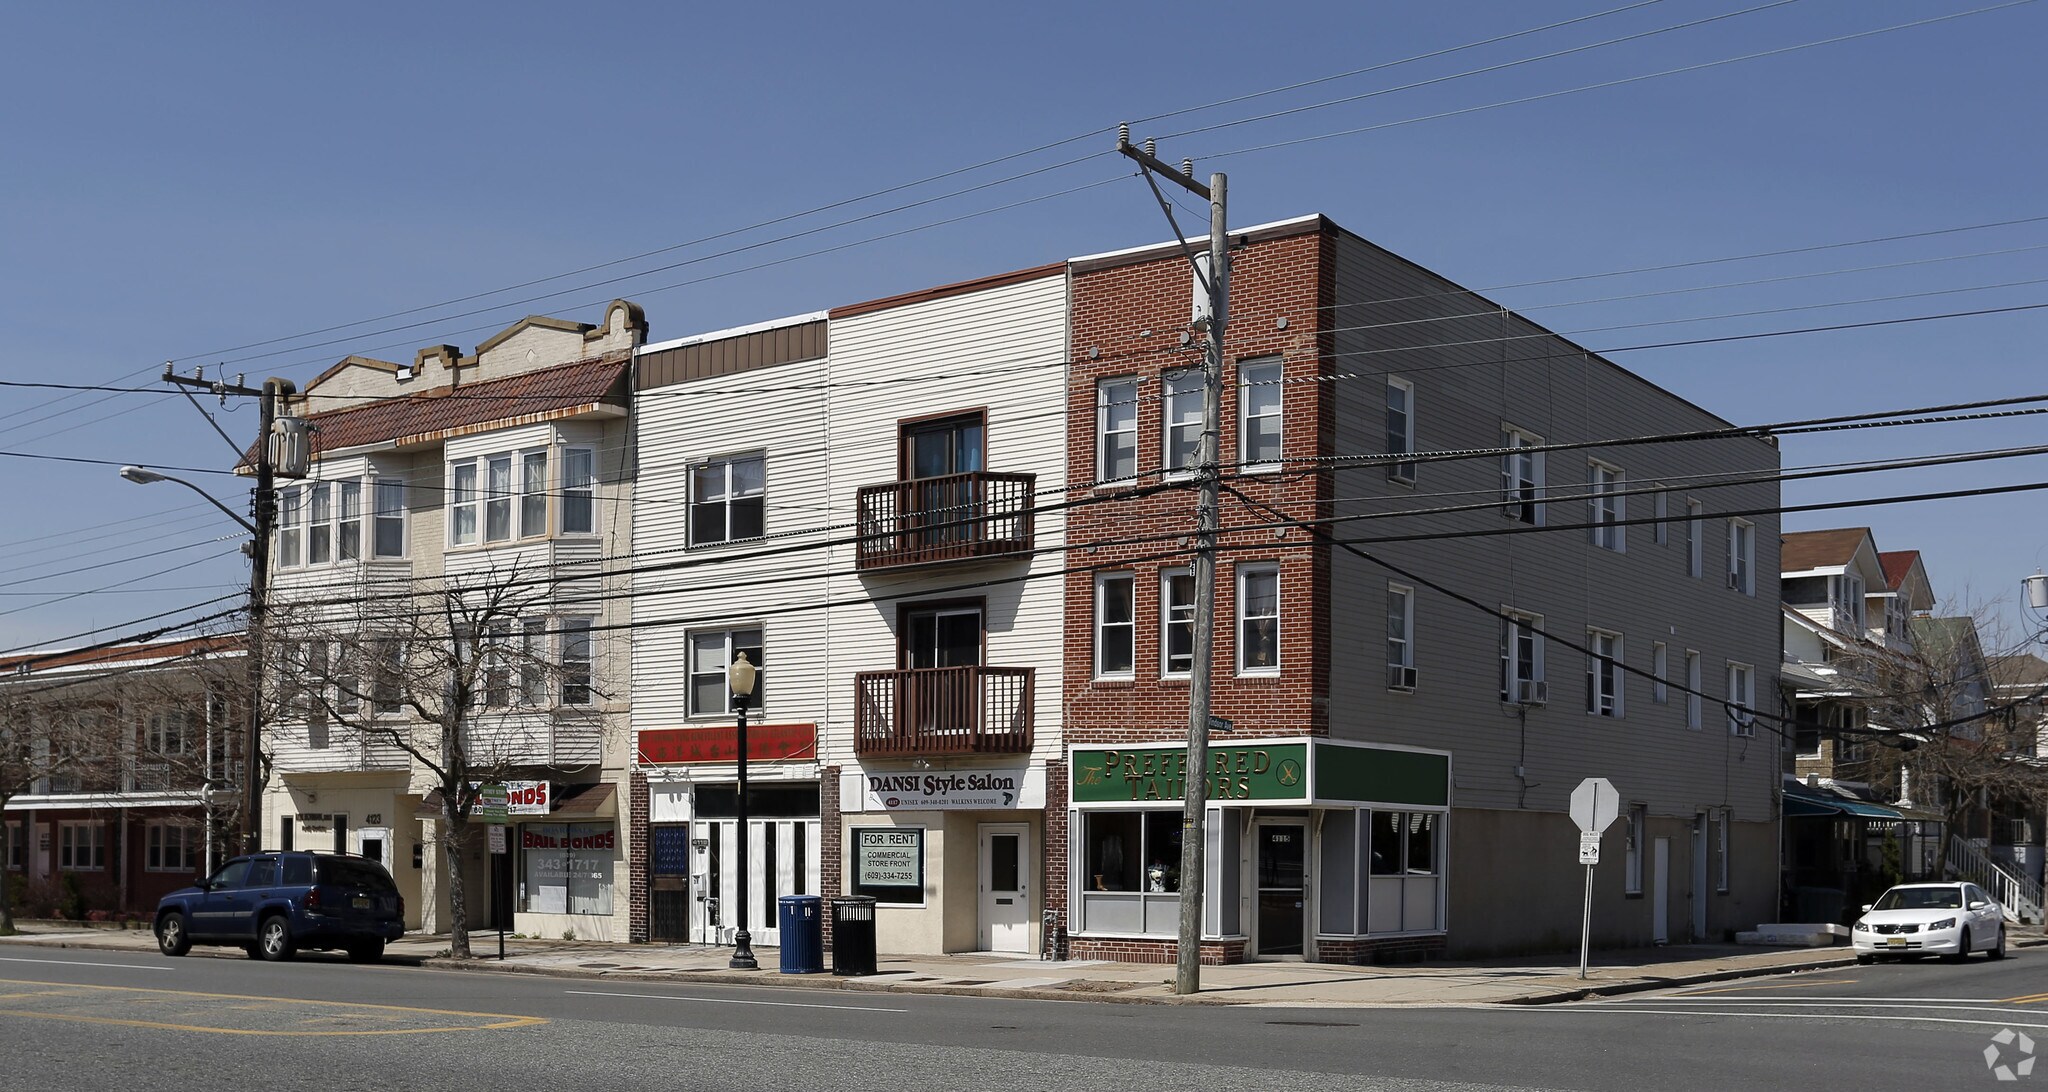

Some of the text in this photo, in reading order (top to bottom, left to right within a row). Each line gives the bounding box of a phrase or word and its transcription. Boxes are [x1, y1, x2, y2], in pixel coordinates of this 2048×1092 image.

[1105, 750, 1271, 777] PREFERED
[1076, 765, 1102, 785] The
[869, 773, 1015, 796] DANSI Style Salon
[365, 814, 382, 824] 4123
[522, 830, 558, 850] BAIL
[560, 829, 615, 850] BONDS
[864, 834, 915, 844] FOR RENT
[867, 851, 911, 859] COMMERCIAL
[864, 871, 913, 880] (609)-334-7255
